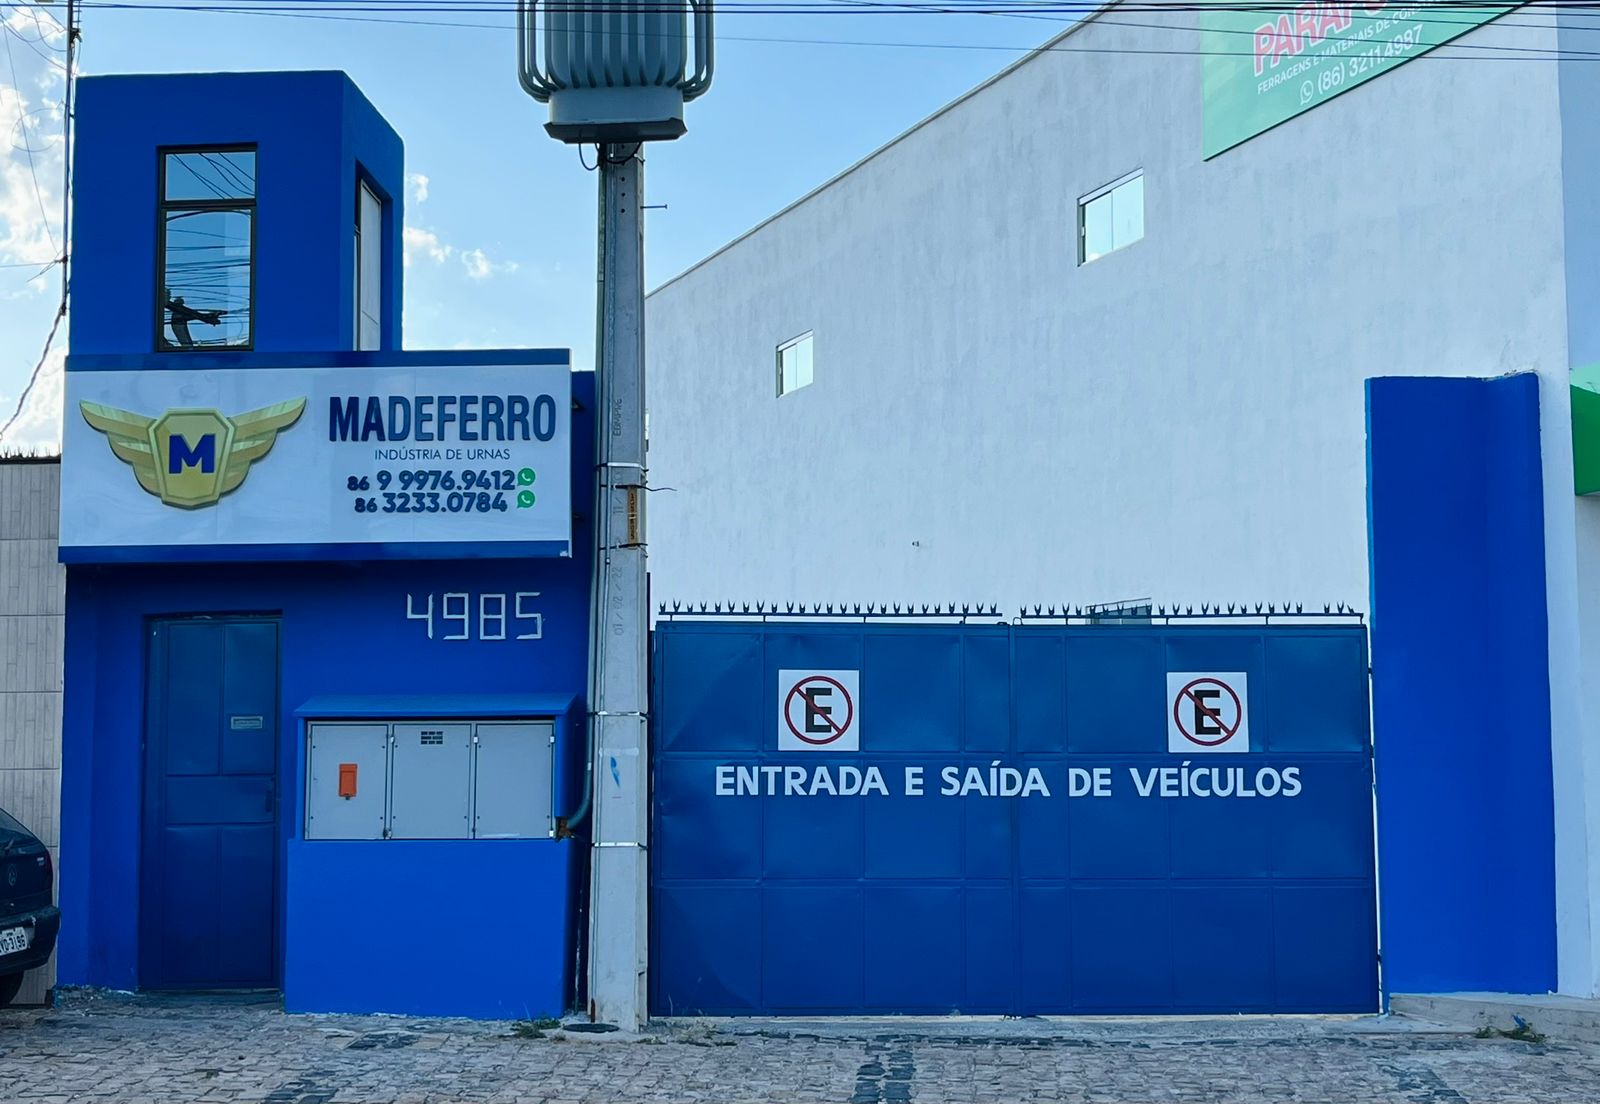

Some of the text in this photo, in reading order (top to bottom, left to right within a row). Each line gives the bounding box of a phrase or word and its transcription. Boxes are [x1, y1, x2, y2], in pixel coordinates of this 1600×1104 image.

[1257, 57, 1312, 95] FERRAGENS
[1320, 25, 1374, 62] MATERIAIS
[1375, 16, 1390, 34] DE
[1317, 23, 1423, 95] (86) 3211.4987
[328, 394, 557, 442] MADEFERRO
[168, 433, 216, 475] M
[374, 446, 511, 460] INDÚSTRIA DE URNAS
[347, 469, 516, 491] 86 9 9976.9412
[354, 491, 508, 513] 86 3233.0784
[405, 591, 543, 641] 4985
[804, 687, 832, 733] E
[1193, 689, 1221, 735] E
[714, 760, 1303, 798] ENTRADA E SAÍDA DE VEÍCULOS
